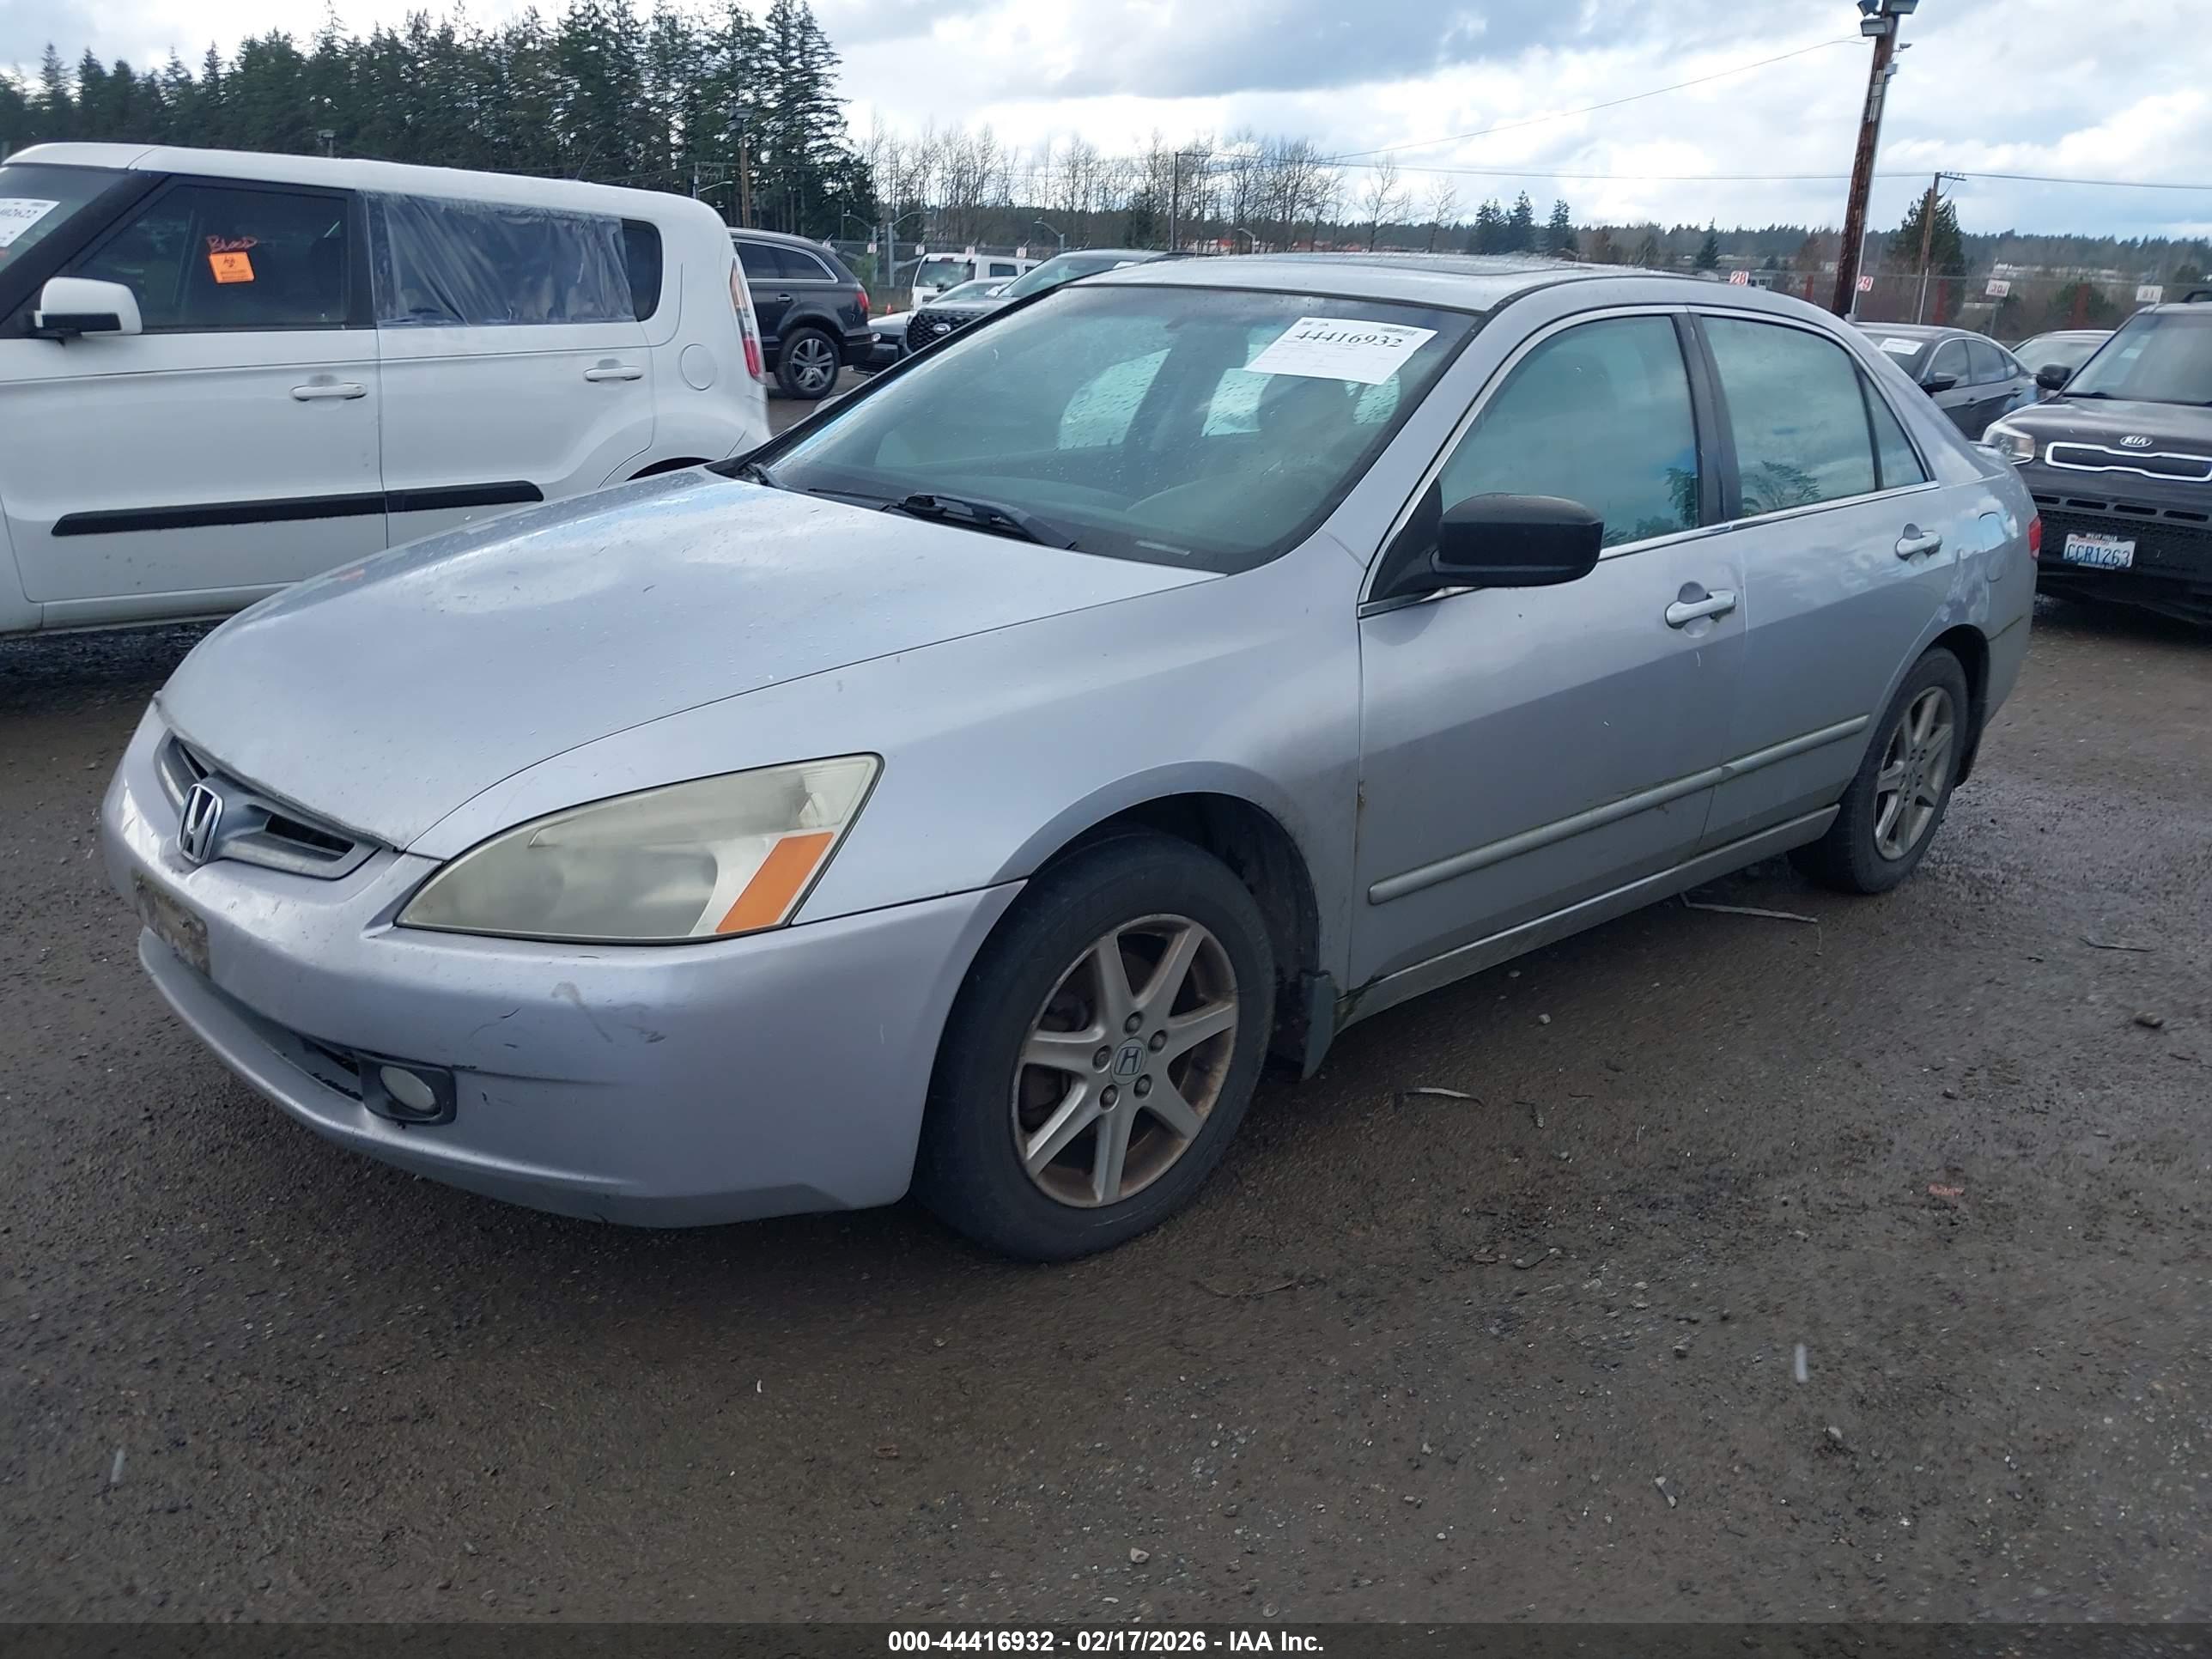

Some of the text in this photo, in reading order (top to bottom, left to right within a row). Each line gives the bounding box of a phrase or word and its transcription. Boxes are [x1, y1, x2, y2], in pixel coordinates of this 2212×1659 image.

[1731, 272, 1747, 285] 28
[1295, 330, 1404, 348] 44416932
[2066, 543, 2130, 567] CCR1263
